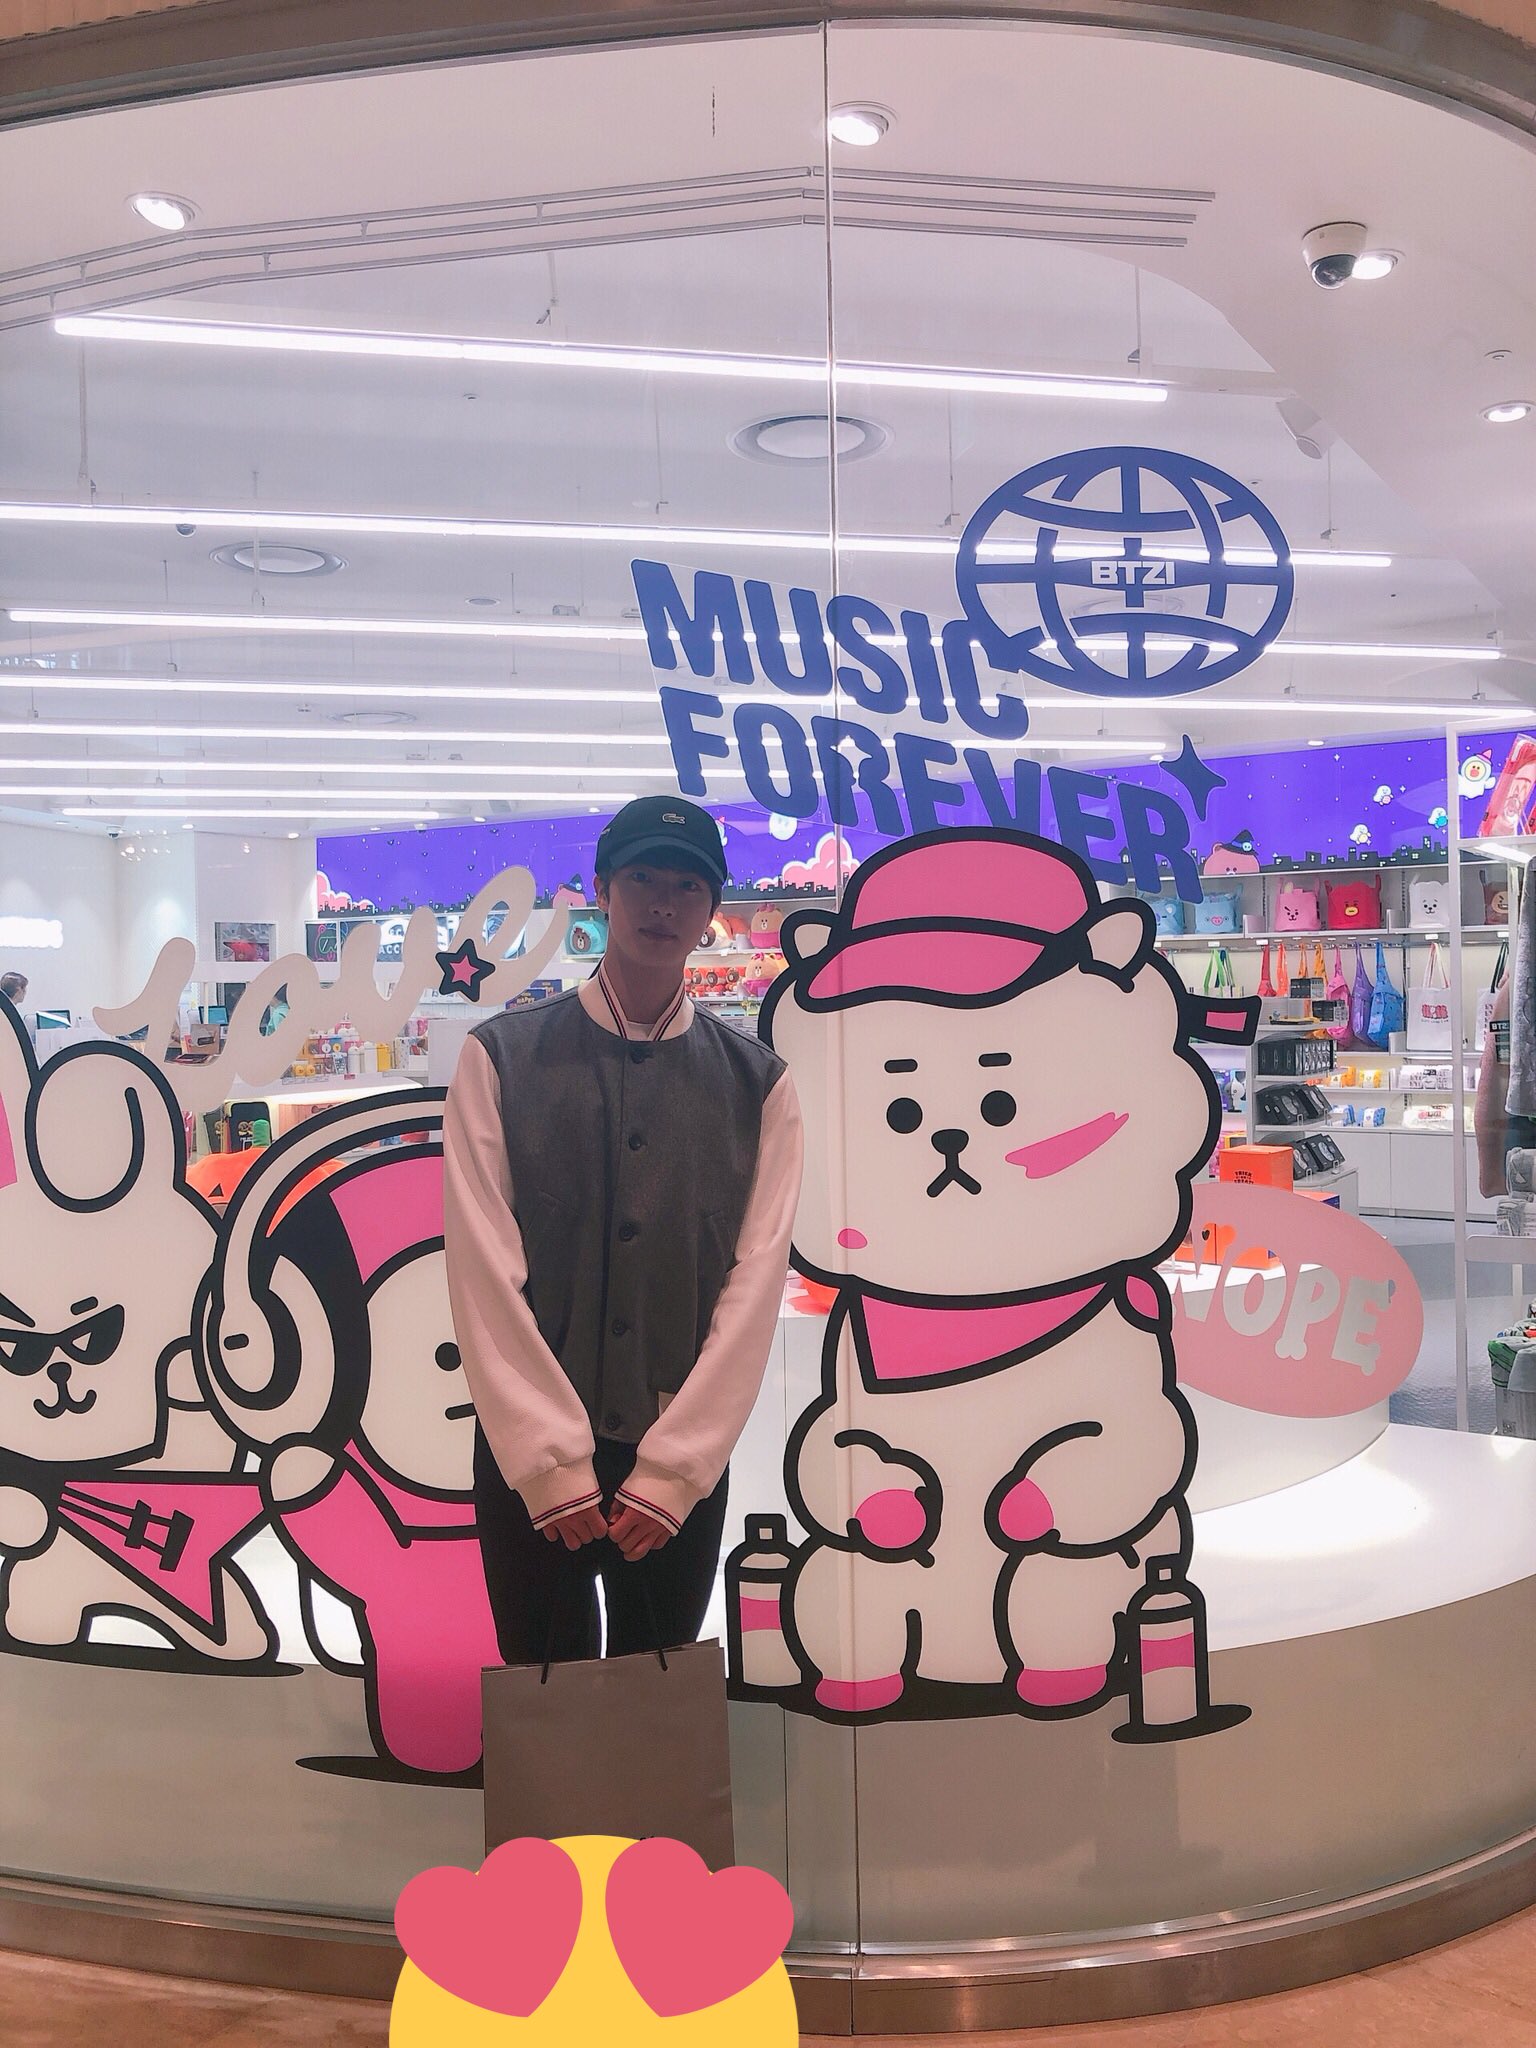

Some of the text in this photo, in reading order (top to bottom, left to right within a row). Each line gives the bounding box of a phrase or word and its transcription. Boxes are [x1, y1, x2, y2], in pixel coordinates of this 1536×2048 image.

[631, 559, 1030, 740] MUSIC
[660, 687, 1204, 903] FOREVER
[1153, 1222, 1397, 1376] NOPE
